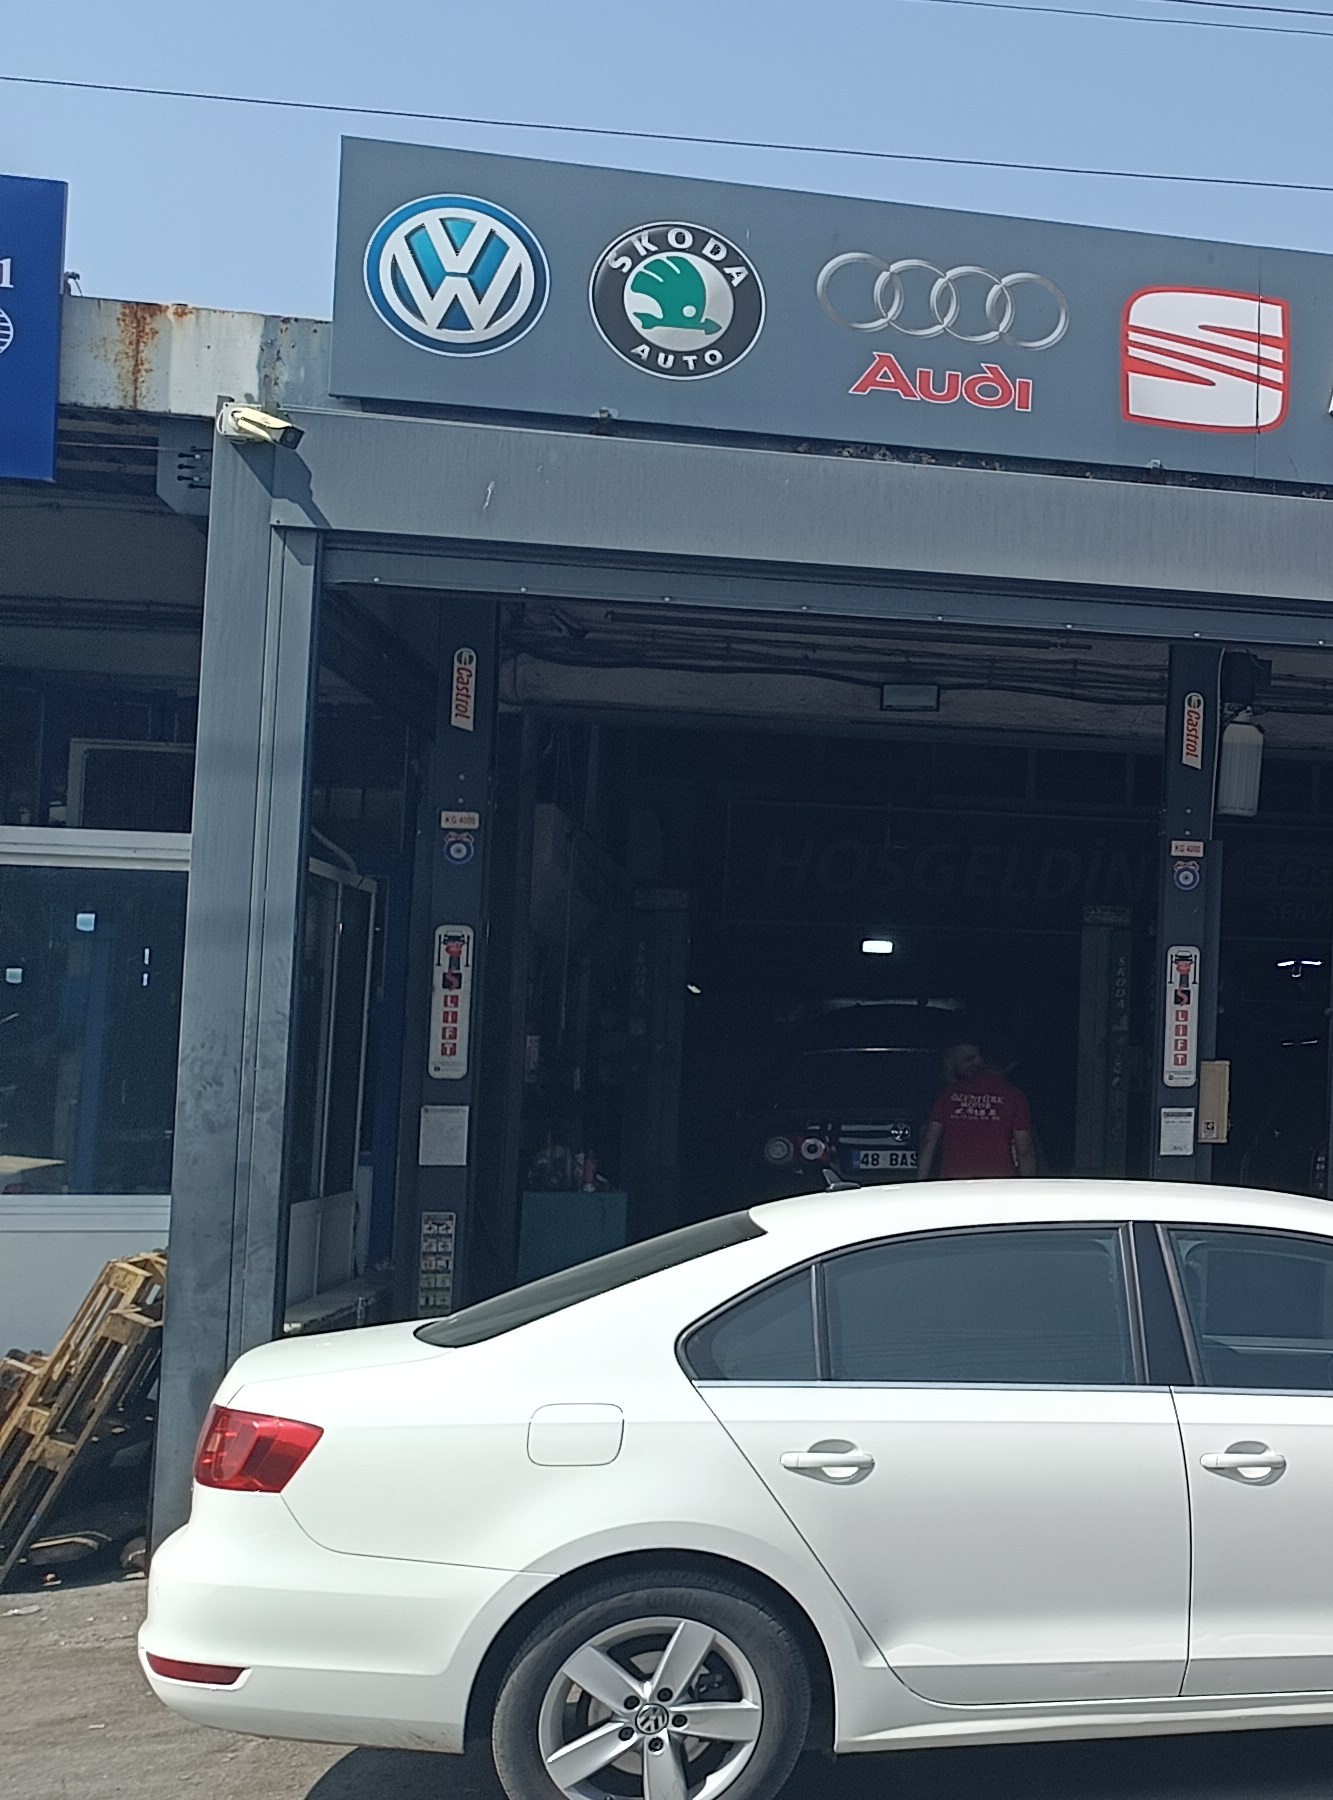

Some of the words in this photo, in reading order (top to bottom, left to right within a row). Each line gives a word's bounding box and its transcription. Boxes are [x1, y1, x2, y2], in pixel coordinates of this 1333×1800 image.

[631, 343, 724, 371] AUTO
[849, 351, 1033, 412] Audi
[455, 667, 473, 719] Castrol
[1186, 709, 1201, 757] Castrol
[445, 816, 457, 825] KG
[1174, 844, 1185, 853] KG
[1186, 844, 1201, 855] 4000
[860, 1152, 880, 1167] 48
